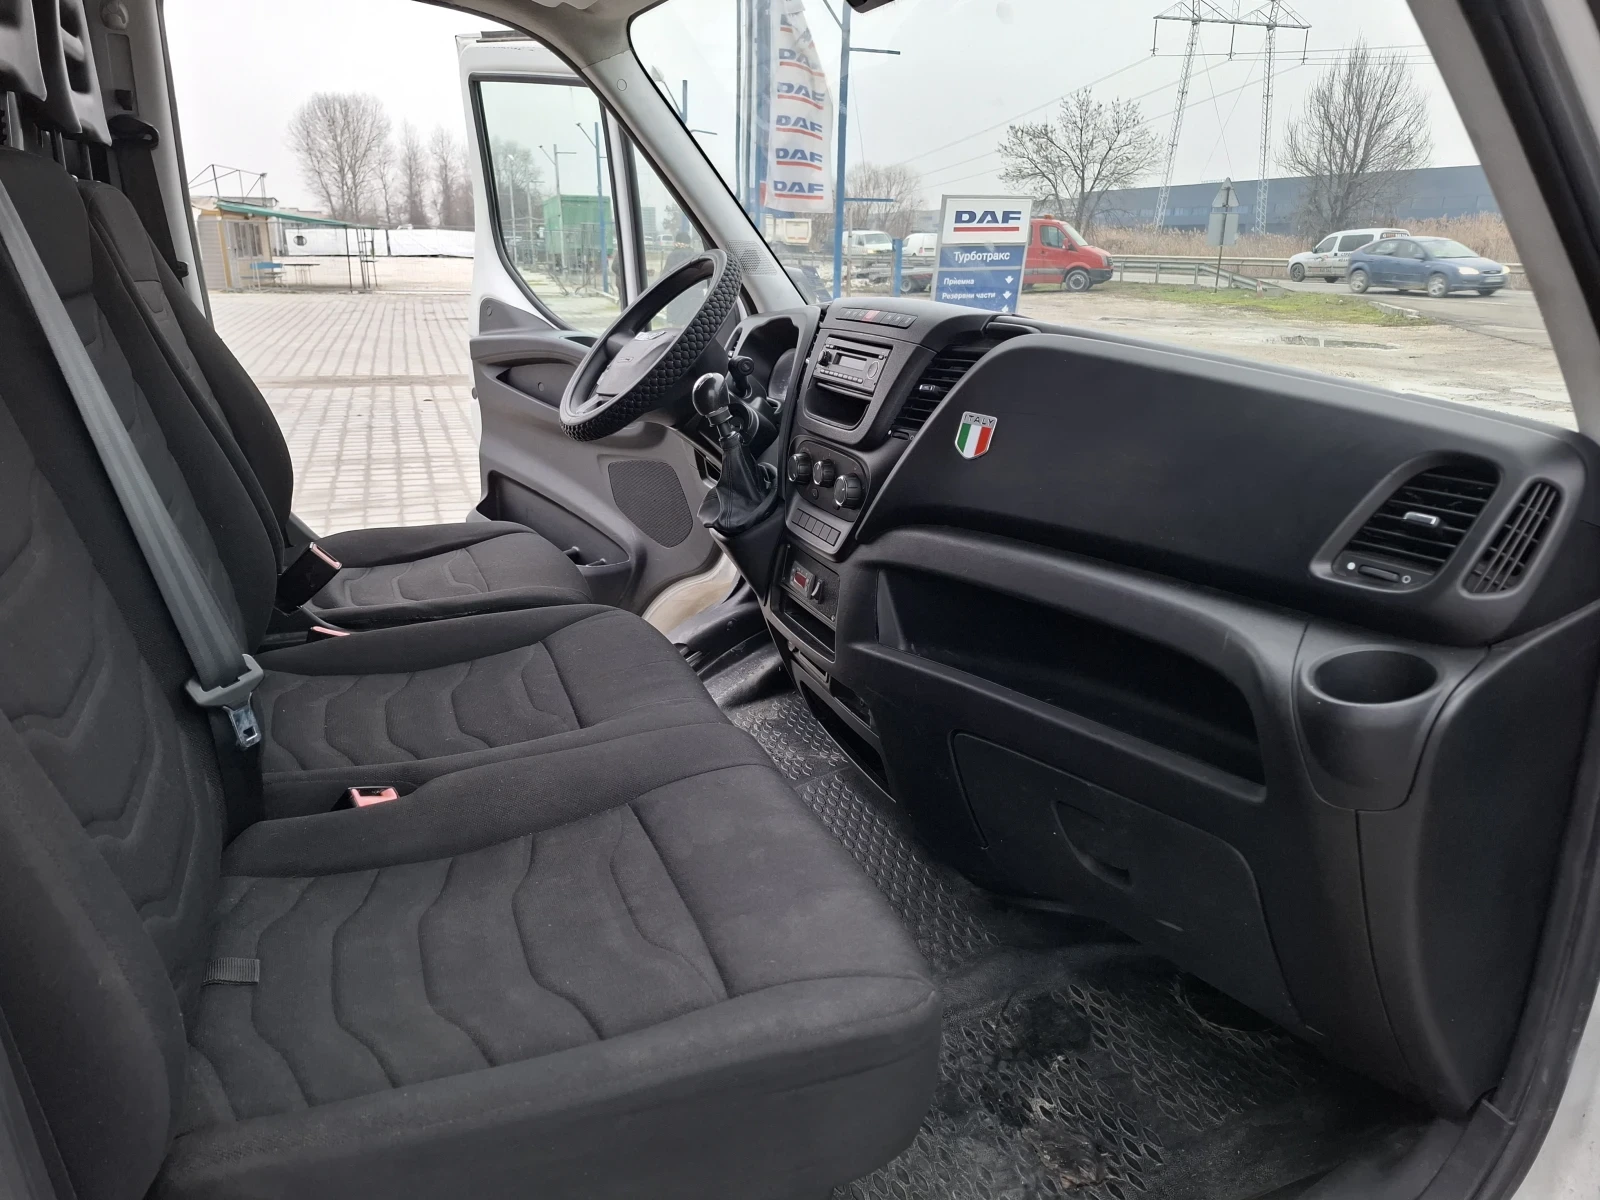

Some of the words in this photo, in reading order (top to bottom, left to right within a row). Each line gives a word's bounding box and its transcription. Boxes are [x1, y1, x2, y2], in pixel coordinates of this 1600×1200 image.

[777, 82, 825, 101] DAF
[776, 115, 822, 133] DAF
[775, 148, 822, 163] DAF
[773, 181, 824, 194] DAF
[954, 210, 1021, 224] DAF
[953, 250, 1010, 263] Турботракс
[963, 414, 994, 426] ITALY
